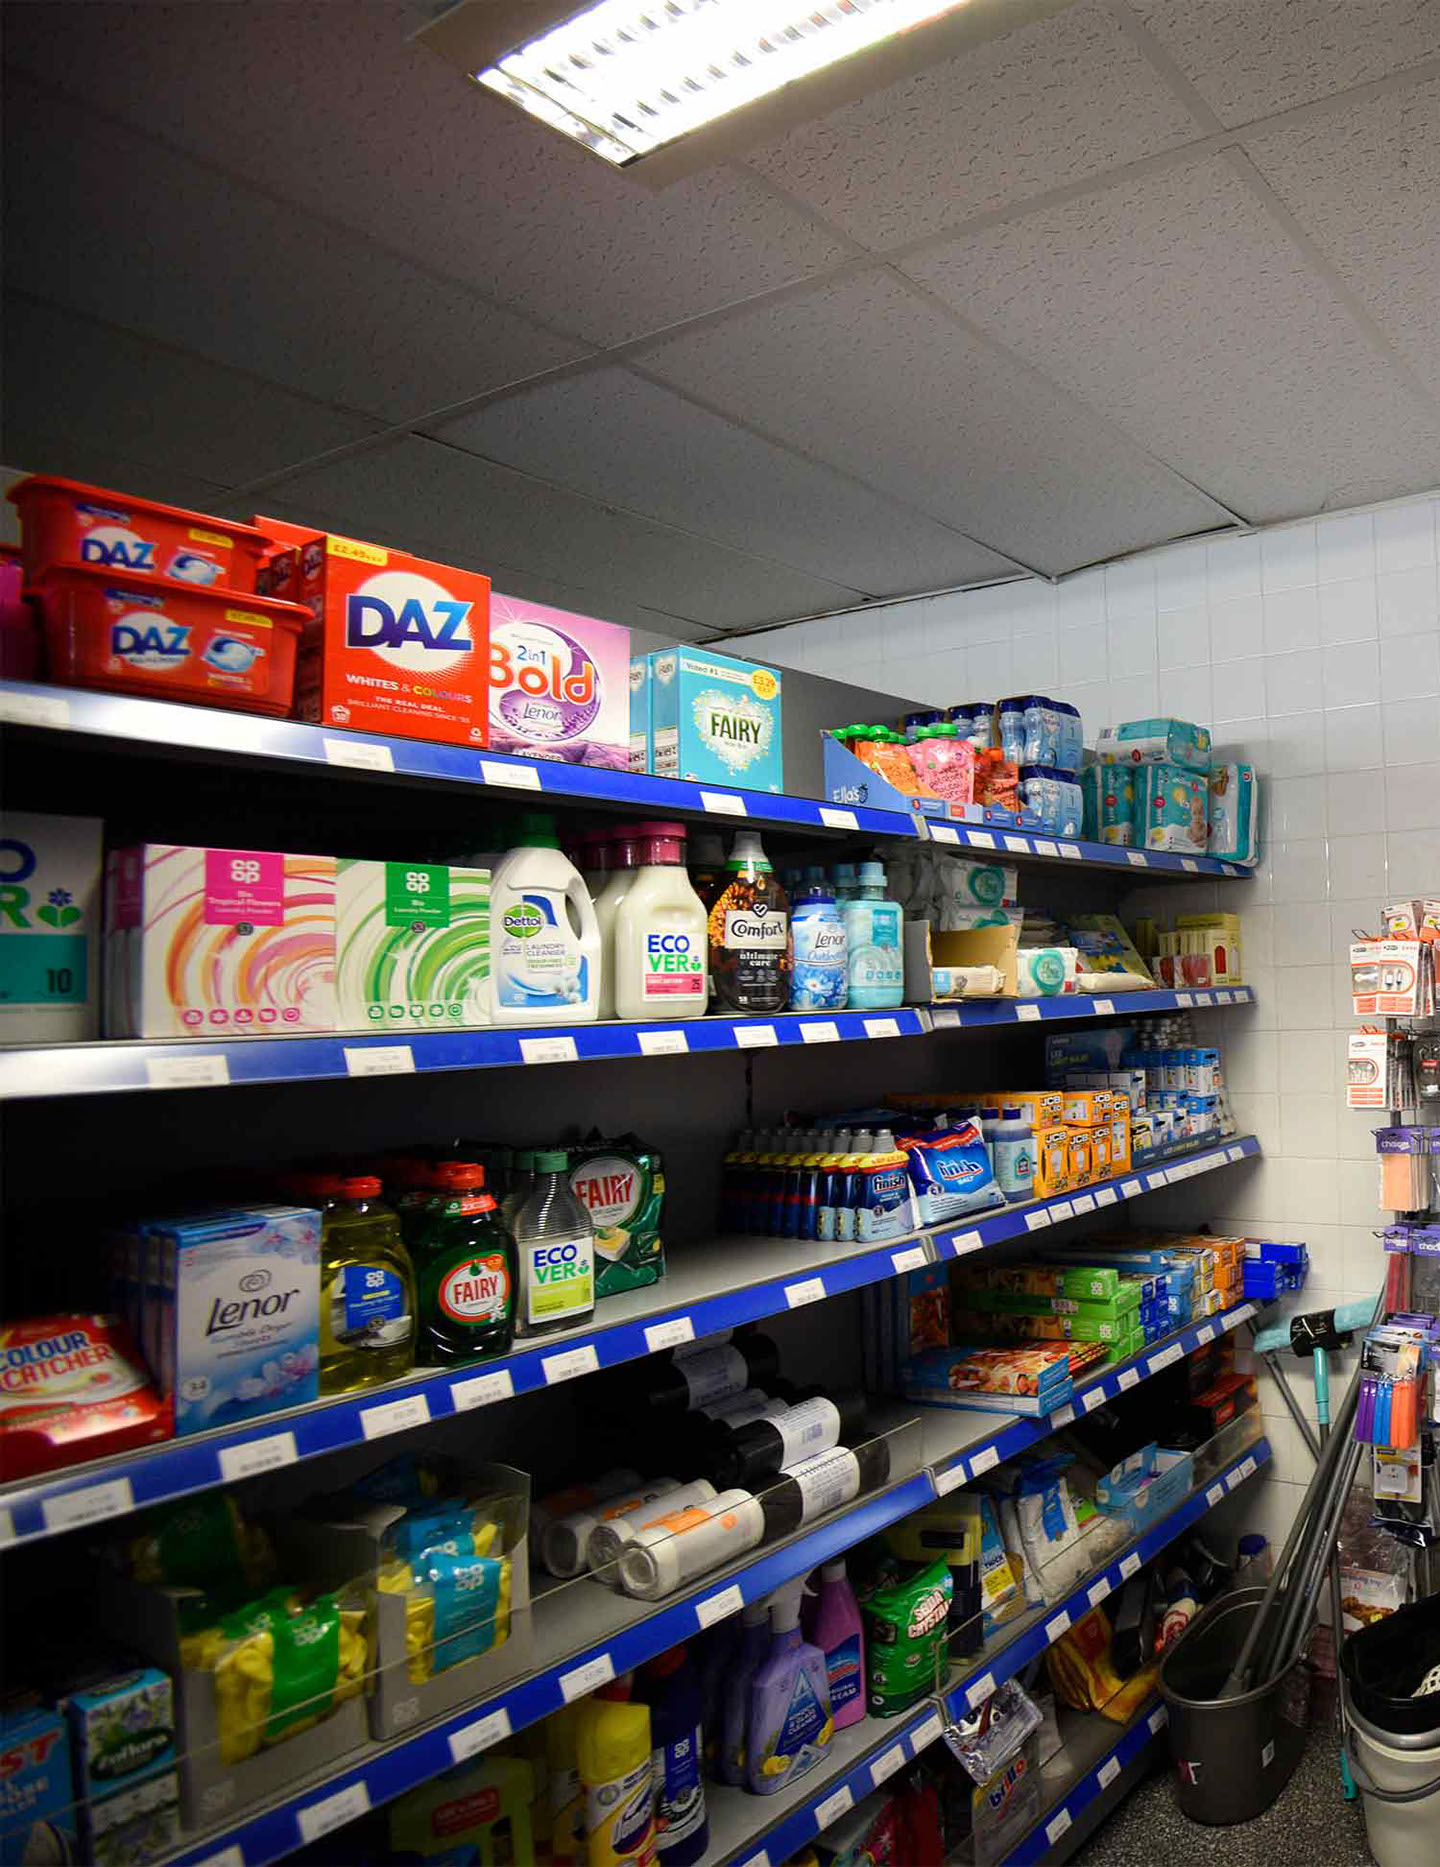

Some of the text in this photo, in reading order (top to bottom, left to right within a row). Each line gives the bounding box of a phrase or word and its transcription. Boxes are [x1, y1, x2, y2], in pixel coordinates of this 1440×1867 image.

[80, 538, 157, 571] DAZ
[345, 593, 474, 652] DAZ
[111, 625, 193, 656] DAZ
[490, 642, 594, 704] Bold
[345, 674, 473, 704] WHITES & COLOURS
[523, 702, 562, 722] Lenor
[710, 712, 762, 744] FAIRY
[503, 915, 542, 926] Dettol
[730, 919, 784, 939] Comfort
[647, 934, 690, 953] ECO
[814, 932, 846, 949] Lenor
[526, 949, 566, 957] CLEANSER
[648, 954, 690, 972] VER
[749, 959, 773, 967] care
[46, 968, 73, 994] 10
[1041, 1096, 1061, 1107] JCB
[1092, 1093, 1111, 1103] JCB
[1114, 1101, 1128, 1111] CB
[1045, 1131, 1067, 1144] JCB
[1070, 1134, 1089, 1144] JCB
[1091, 1127, 1109, 1138] JCB
[937, 1160, 981, 1179] finish
[575, 1171, 635, 1209] FAIRY
[872, 1174, 906, 1192] finish
[533, 1244, 577, 1267] ECO
[533, 1261, 577, 1285] VER
[453, 1275, 498, 1305] FAIRY
[205, 1288, 300, 1337] Lenor
[1, 1343, 114, 1390] CATCHER
